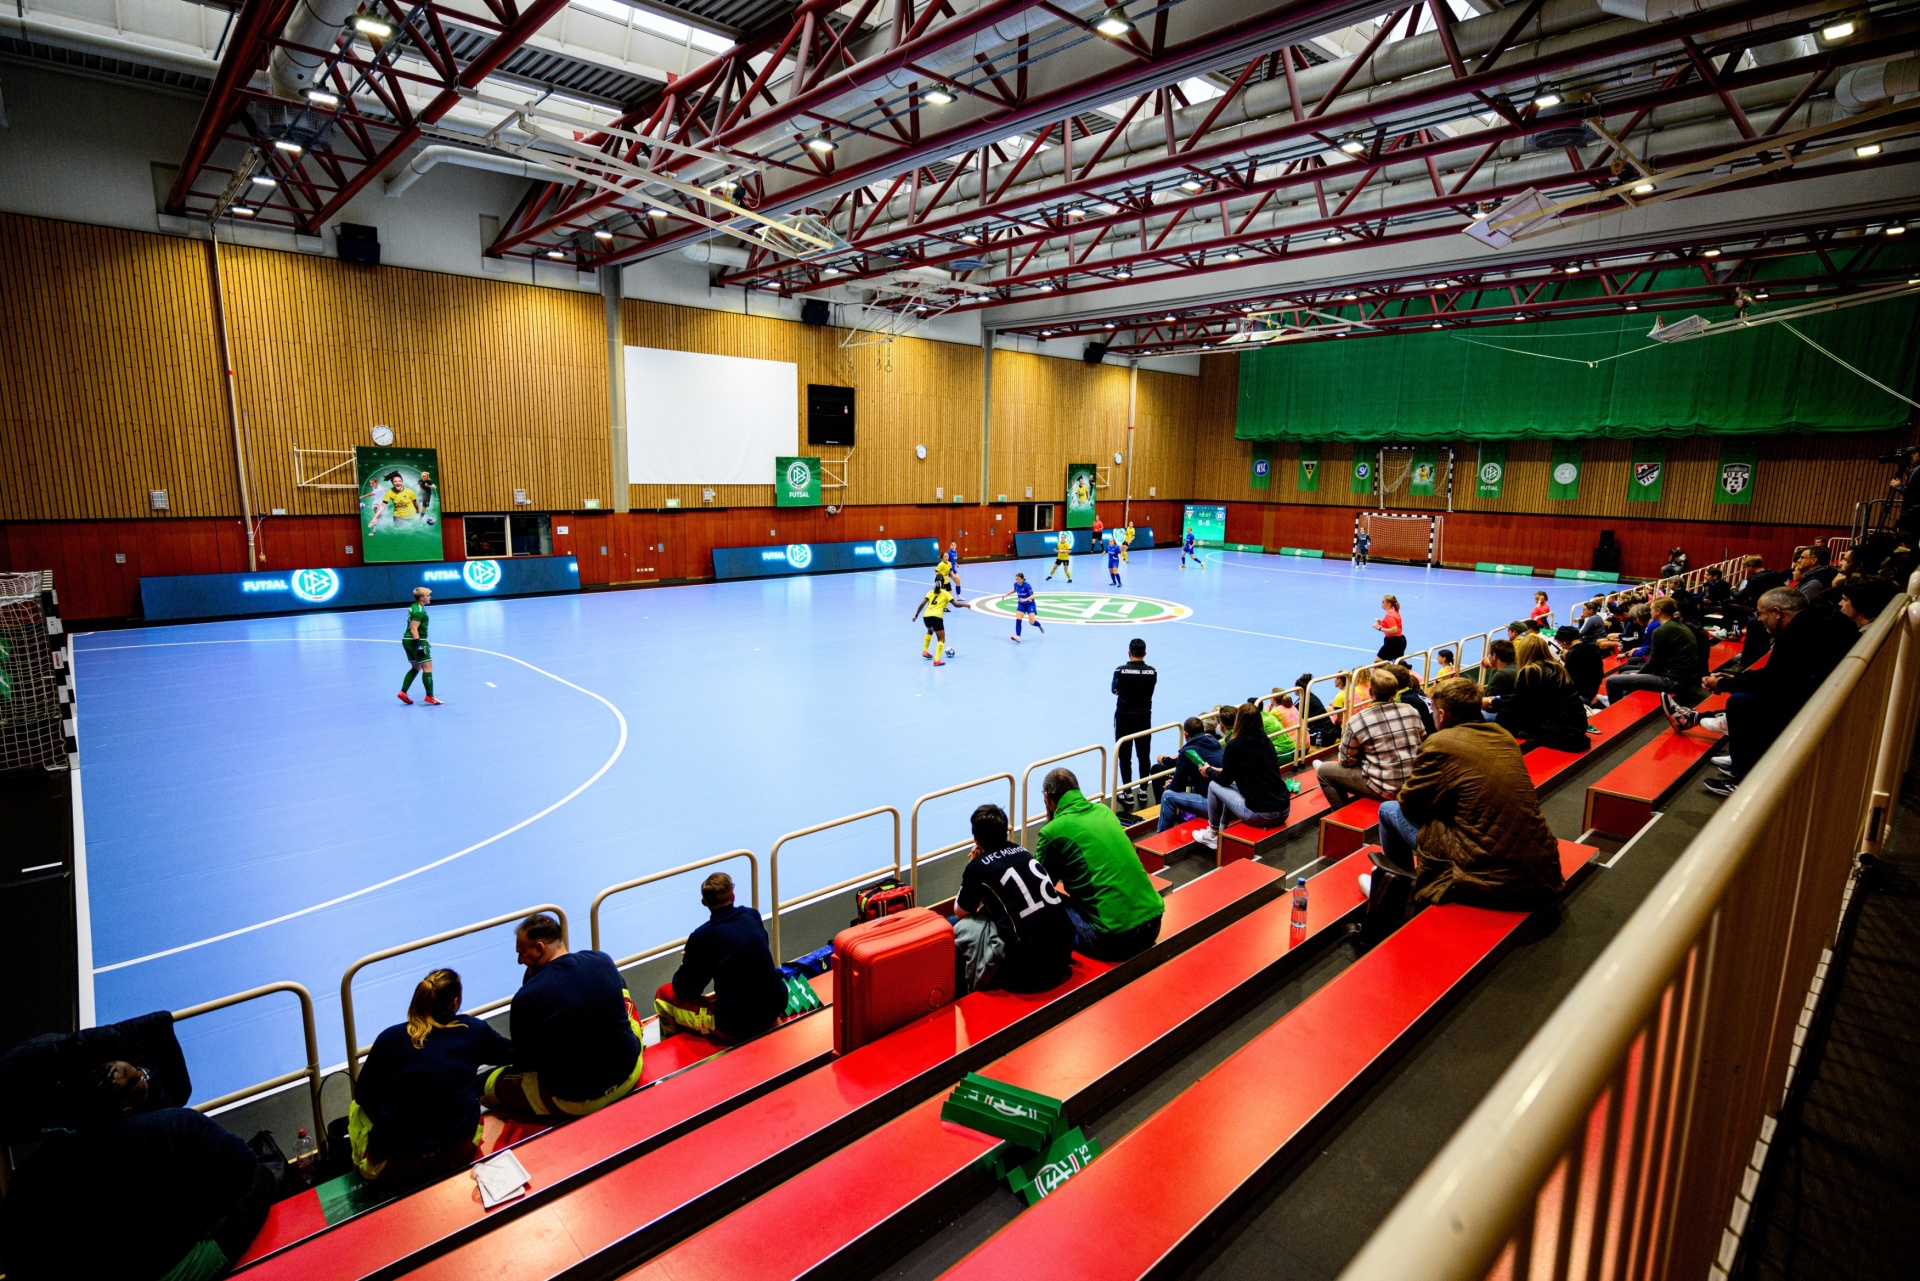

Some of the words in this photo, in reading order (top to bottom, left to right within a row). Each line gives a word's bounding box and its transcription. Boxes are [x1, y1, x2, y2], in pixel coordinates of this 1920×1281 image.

[424, 569, 461, 582] FUTSAL
[242, 579, 289, 592] FUTSAL
[981, 851, 1001, 865] UFC
[999, 858, 1062, 919] 18
